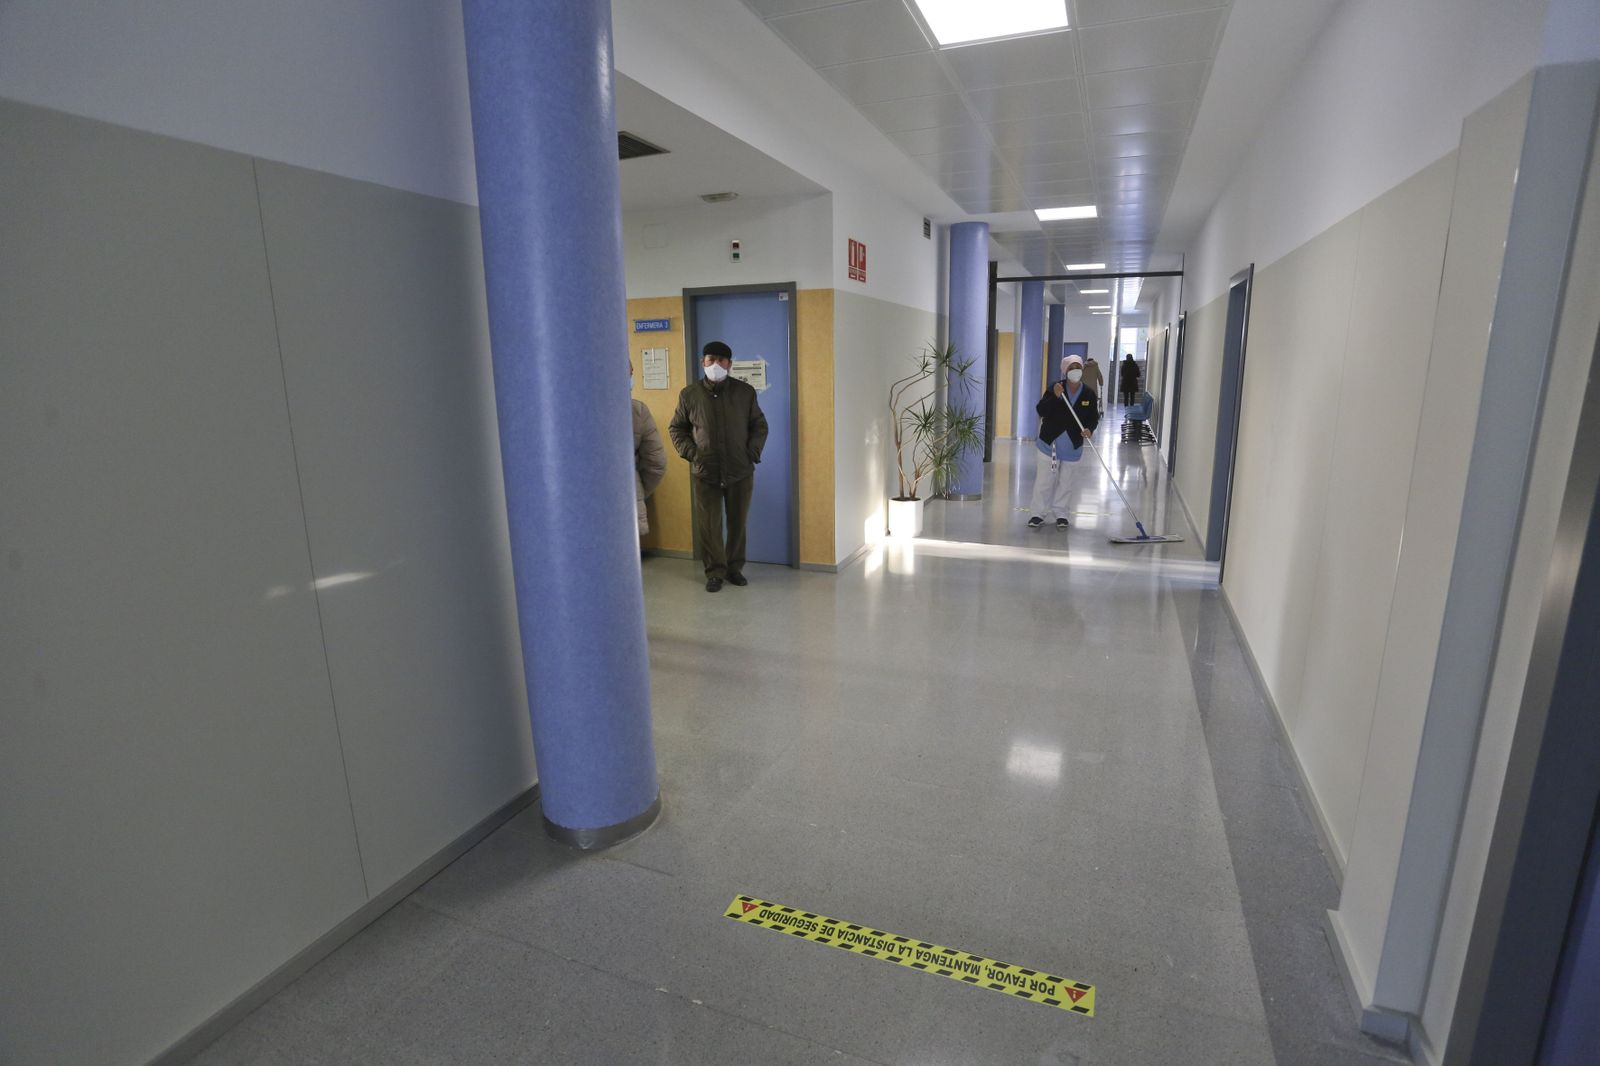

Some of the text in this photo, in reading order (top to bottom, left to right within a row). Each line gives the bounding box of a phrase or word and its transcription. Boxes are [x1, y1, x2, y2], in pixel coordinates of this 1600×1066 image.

[759, 909, 1056, 996] POR FAVOR, MANTENGA LA DISTANCIA DE SEGURIDAD
